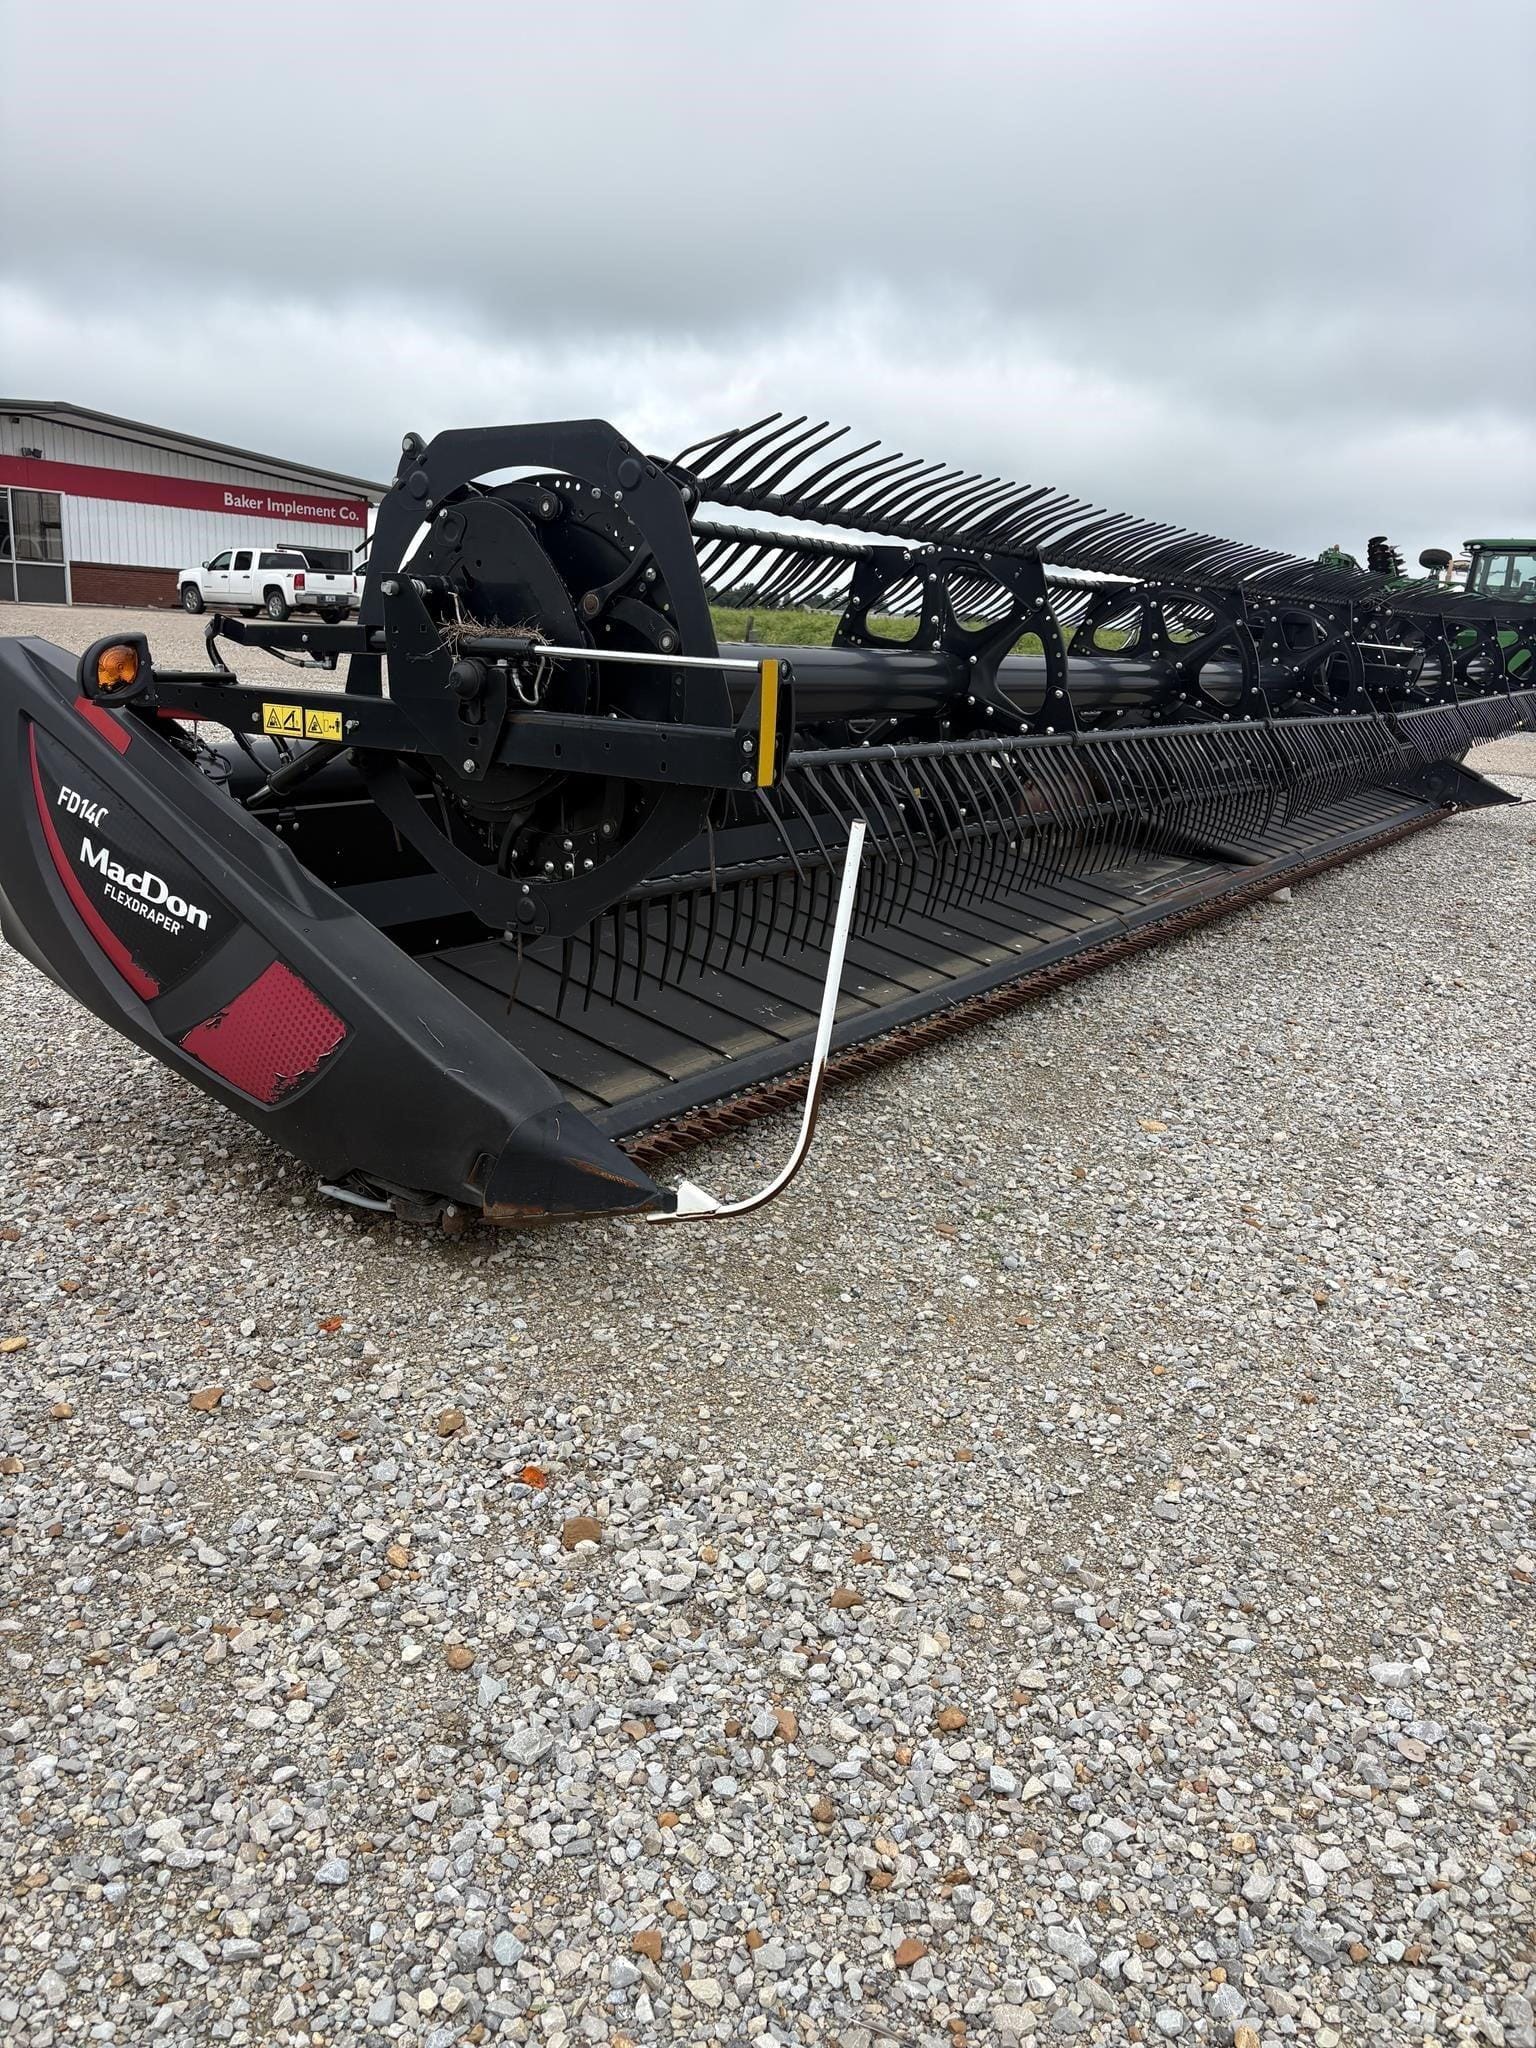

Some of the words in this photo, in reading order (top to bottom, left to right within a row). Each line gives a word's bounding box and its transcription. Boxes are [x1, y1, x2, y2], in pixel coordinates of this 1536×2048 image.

[223, 492, 263, 509] Baker
[267, 497, 336, 518] Implement
[339, 506, 359, 521] Co.
[79, 836, 209, 931] MacDon
[103, 882, 182, 935] FLEXDRAPER
